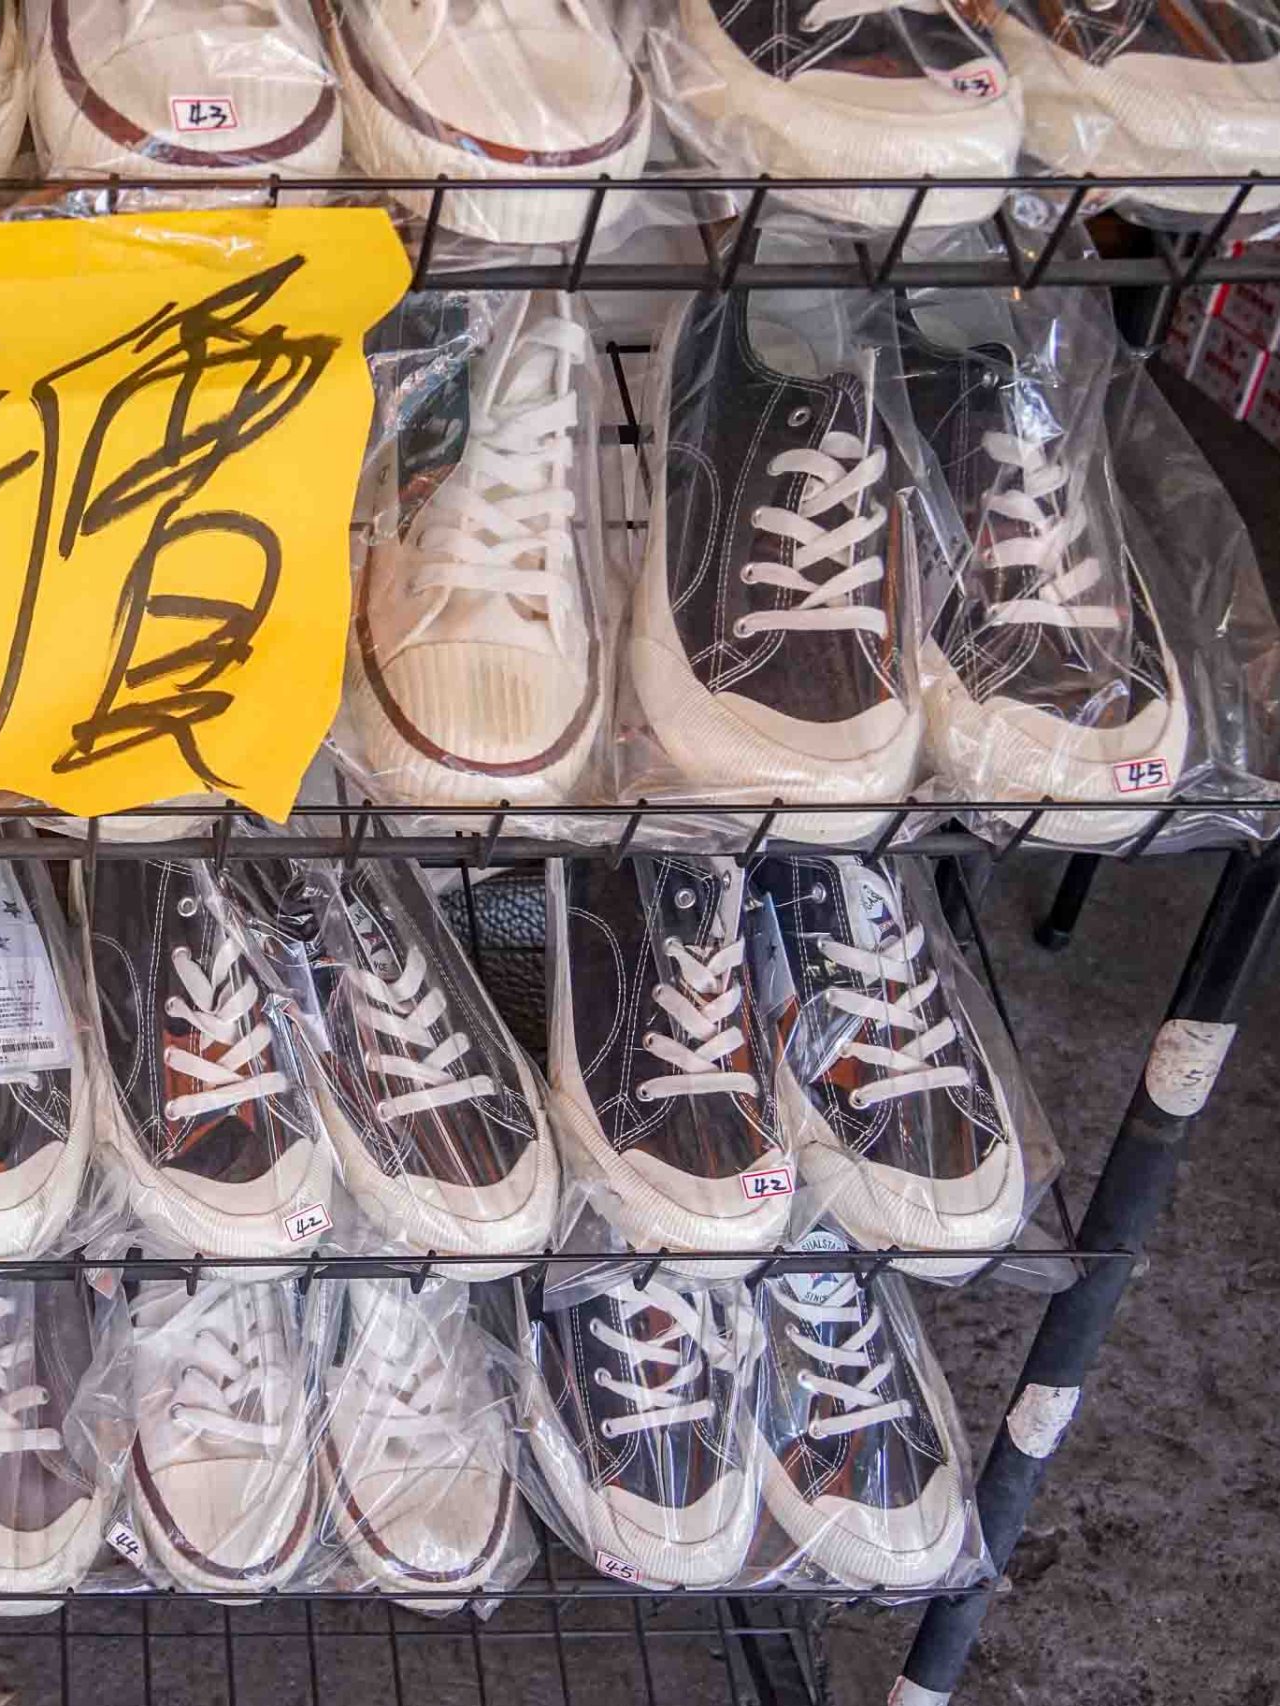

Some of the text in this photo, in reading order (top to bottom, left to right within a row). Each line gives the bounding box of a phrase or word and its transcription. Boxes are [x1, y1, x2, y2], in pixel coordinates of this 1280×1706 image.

[189, 103, 228, 128] 43
[1127, 762, 1163, 790] 45
[754, 1177, 787, 1198] 42
[296, 1216, 322, 1238] 42
[115, 1531, 139, 1556] 44
[605, 1559, 633, 1579] 45
